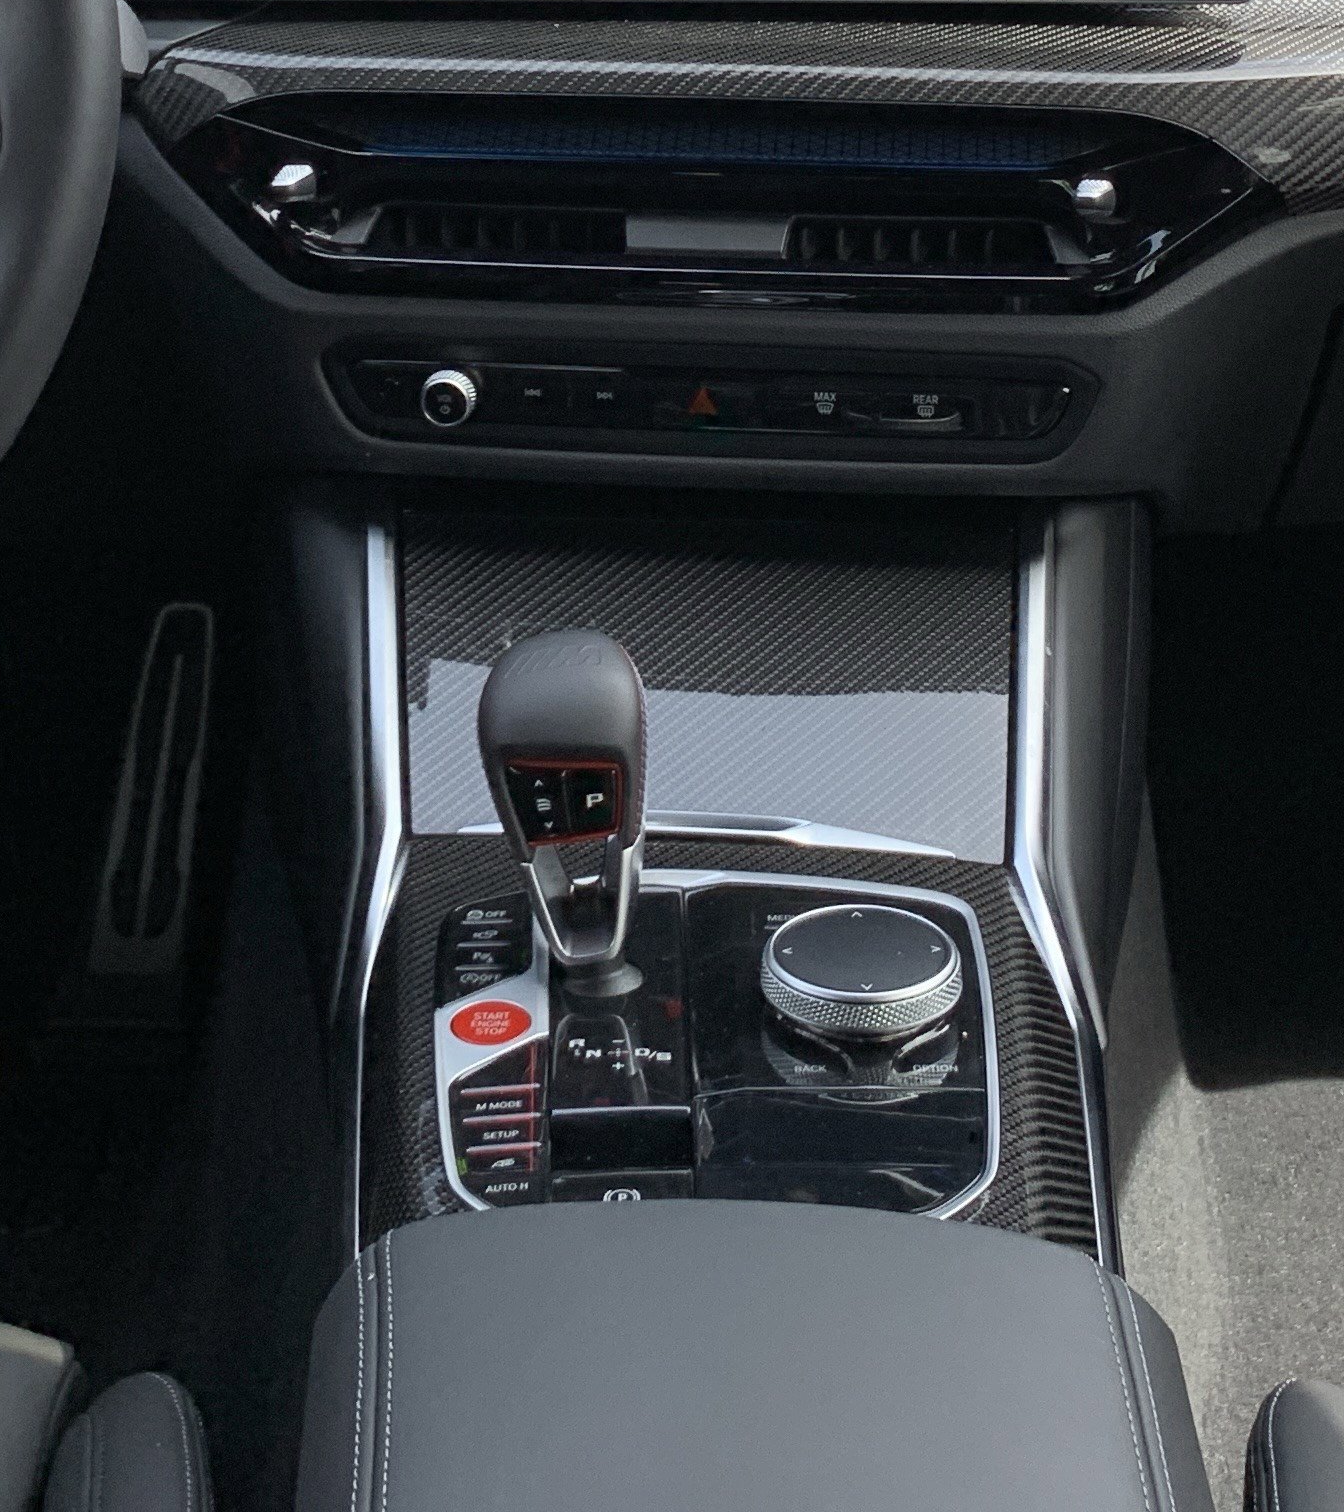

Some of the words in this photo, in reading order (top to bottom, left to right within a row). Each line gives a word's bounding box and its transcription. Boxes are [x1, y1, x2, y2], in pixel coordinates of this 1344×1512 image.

[814, 391, 837, 402] MAX
[912, 393, 939, 405] REAR
[586, 792, 604, 808] P
[485, 909, 507, 918] OFF
[472, 1011, 511, 1020] START
[470, 1019, 511, 1028] ENGINE
[475, 1027, 507, 1036] STOP
[585, 1048, 602, 1059] N
[793, 1065, 827, 1073] BACK
[912, 1064, 959, 1073] OPTION
[475, 1102, 487, 1111] M
[488, 1099, 523, 1110] MODE
[482, 1129, 520, 1140] SETUP
[485, 1182, 518, 1193] AUTO
